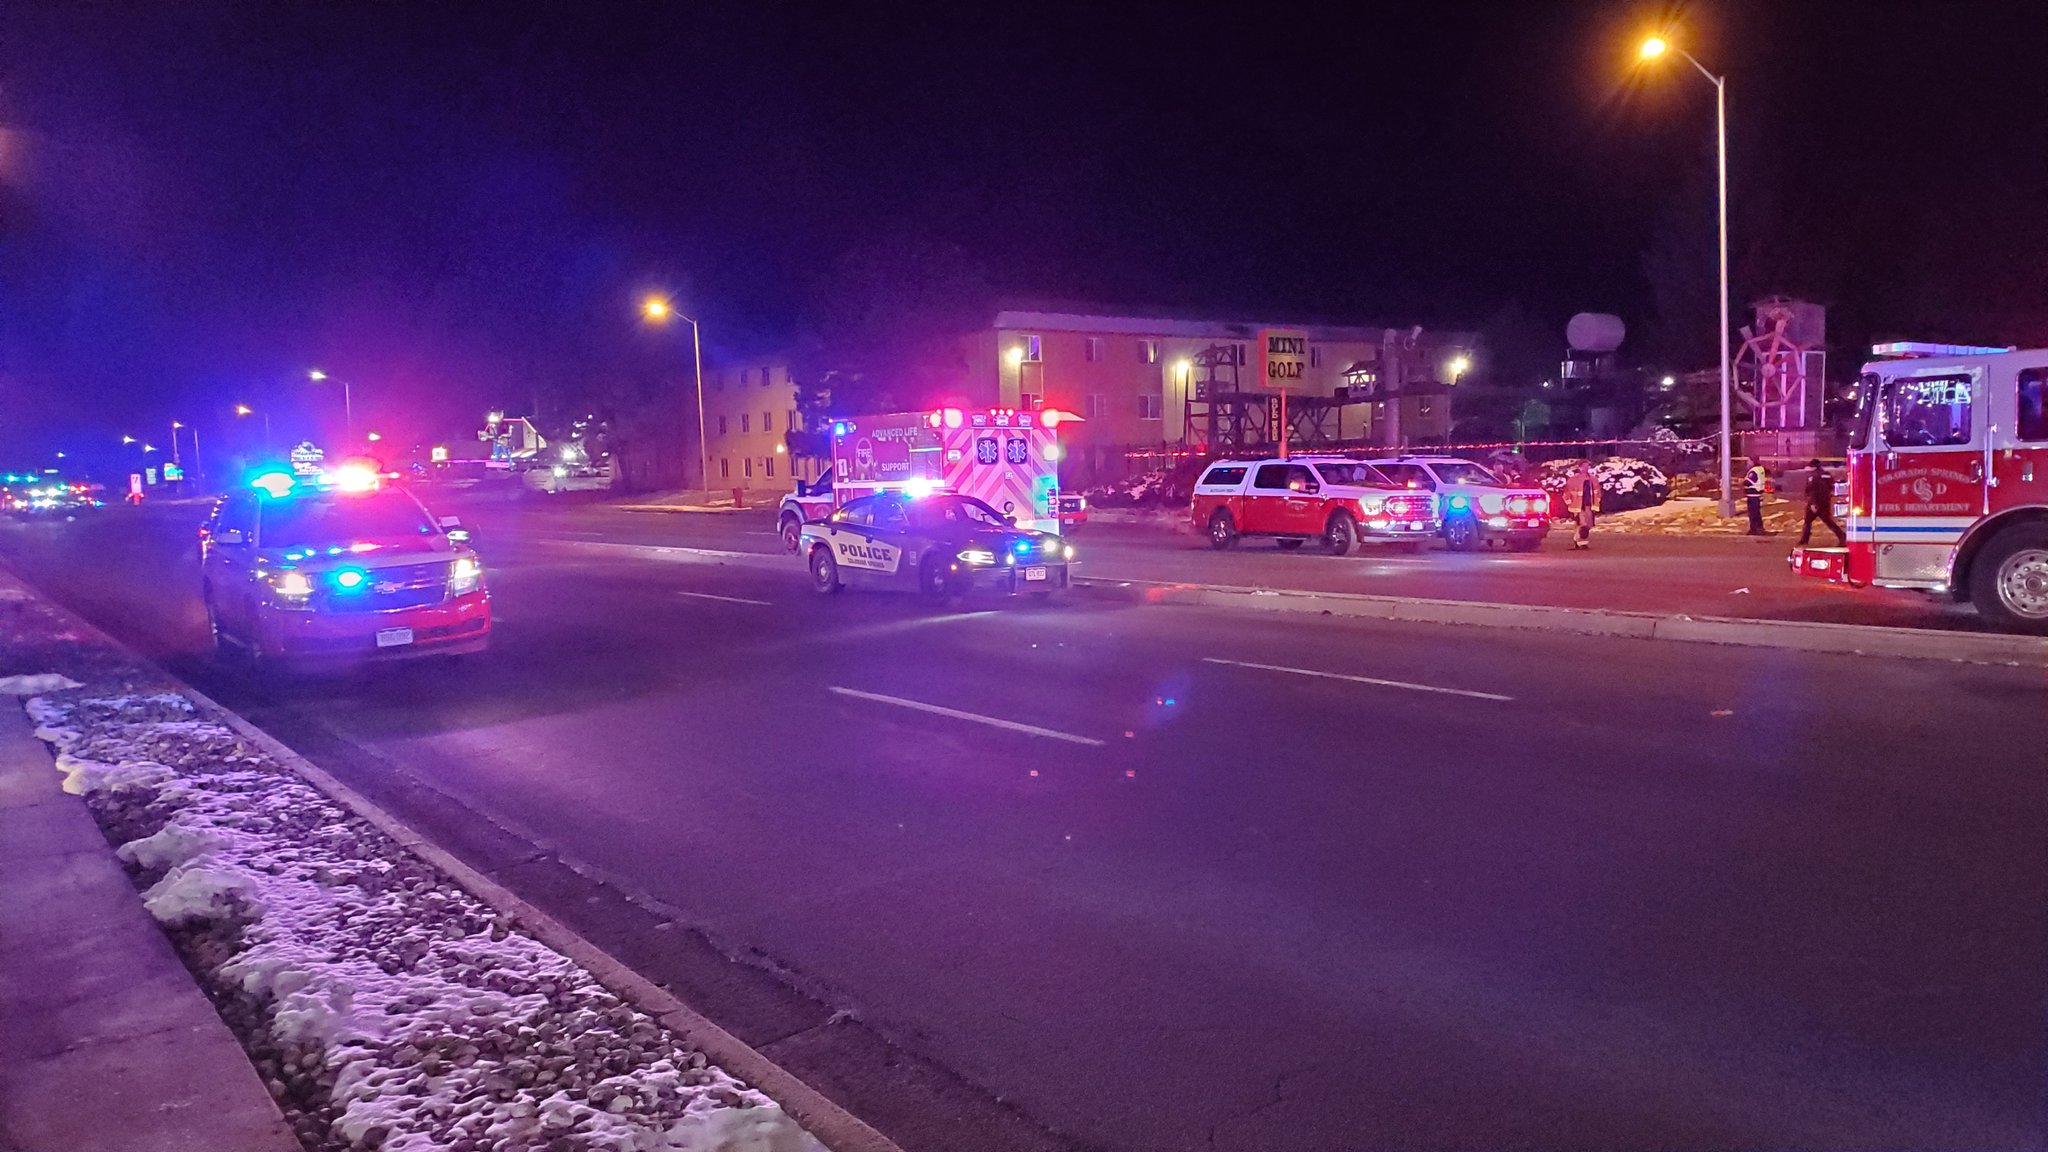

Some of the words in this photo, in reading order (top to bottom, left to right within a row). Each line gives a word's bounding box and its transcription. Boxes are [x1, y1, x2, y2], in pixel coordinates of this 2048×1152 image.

[1268, 337, 1305, 354] MINI
[1268, 361, 1304, 378] GOLF
[872, 428, 903, 438] ADVANCED
[904, 427, 918, 436] LIFE
[857, 448, 872, 458] FIRE
[881, 462, 910, 472] SUPPORT
[1877, 468, 1928, 485] COLORADO
[1931, 467, 1971, 484] SPRINGS
[1936, 483, 1947, 495] D
[1879, 503, 1900, 512] FIRE
[1904, 503, 1971, 512] DEPARTMENT
[839, 543, 892, 561] POLICE
